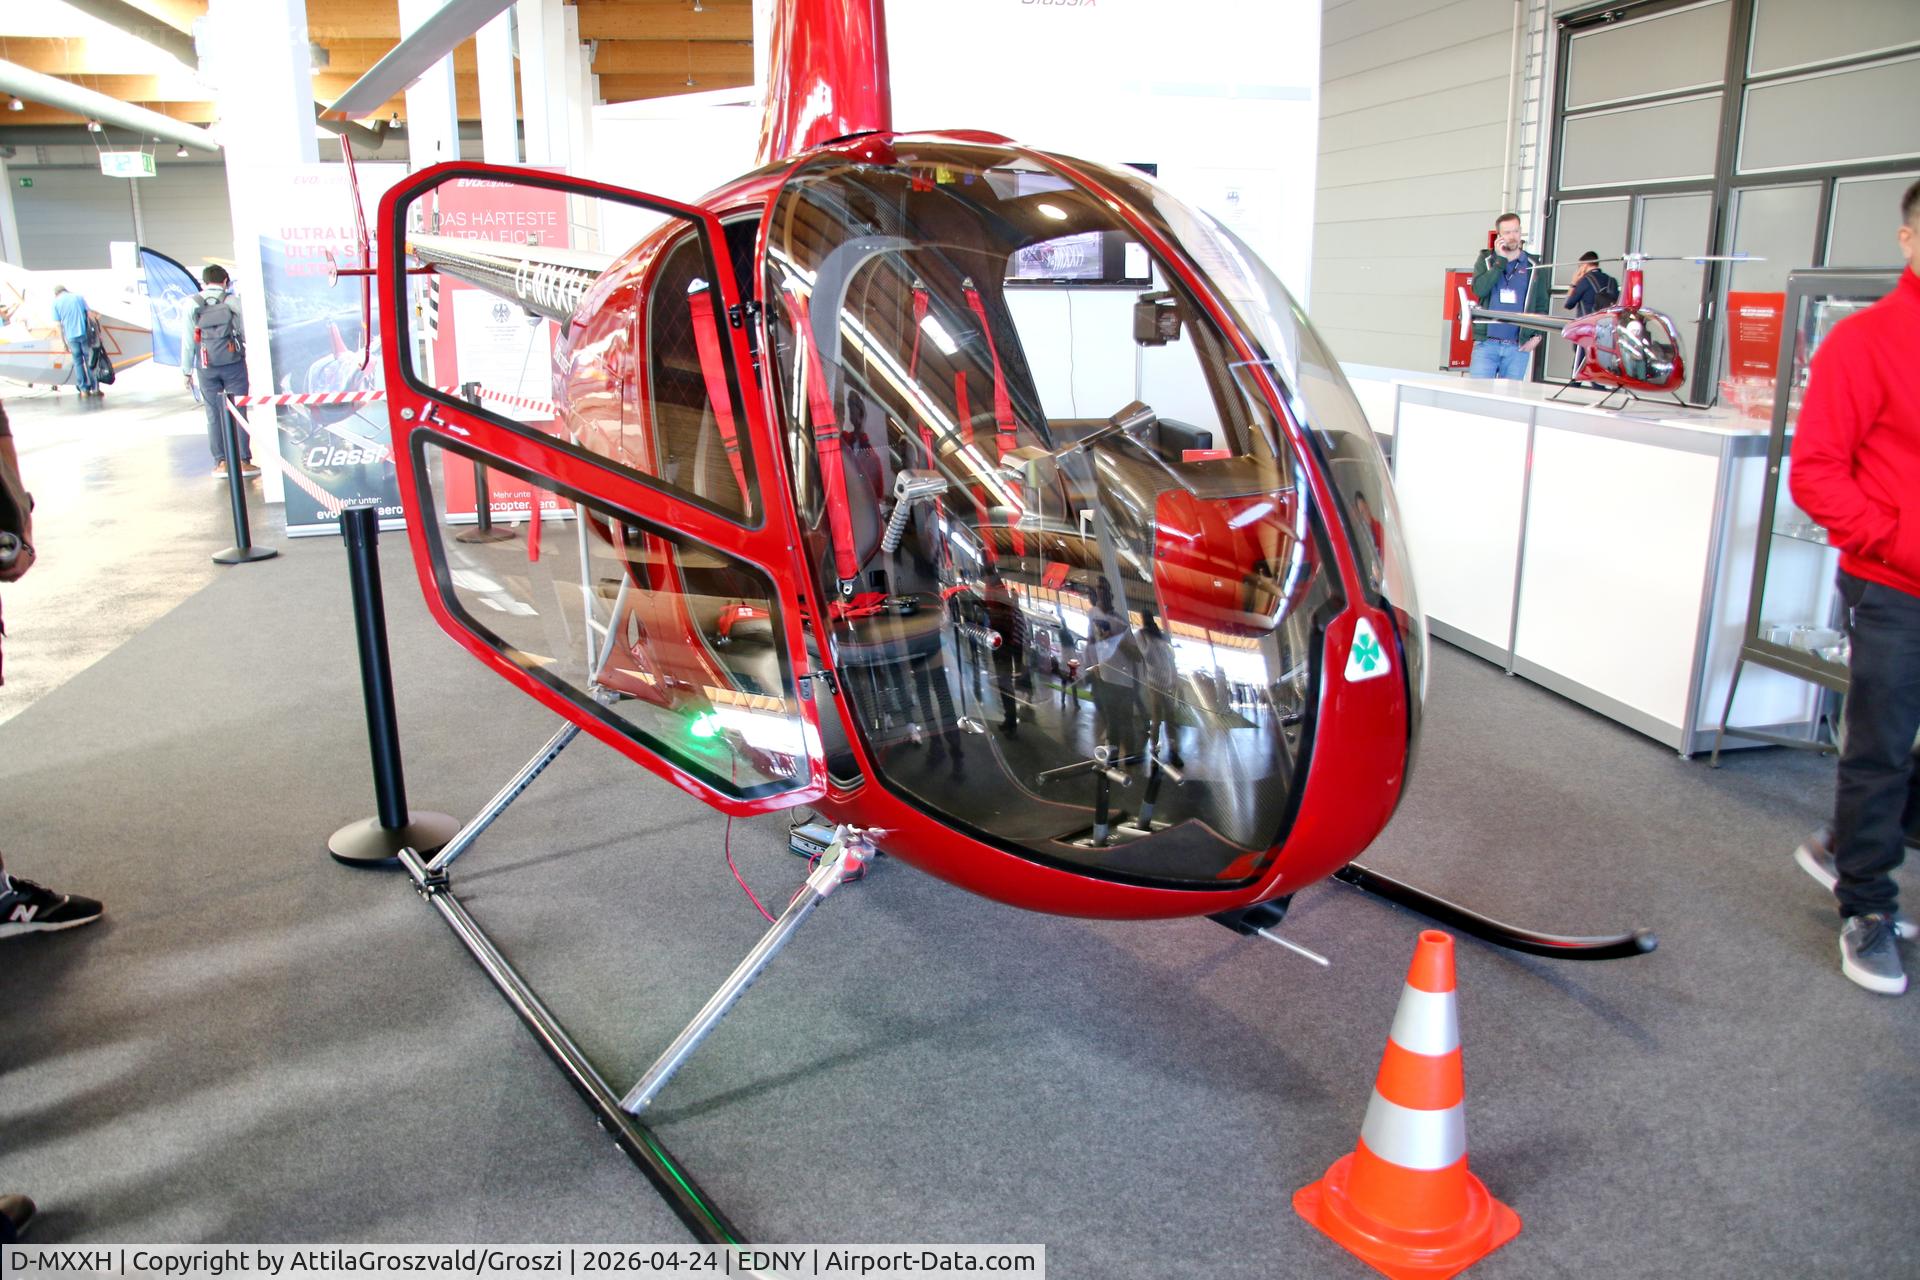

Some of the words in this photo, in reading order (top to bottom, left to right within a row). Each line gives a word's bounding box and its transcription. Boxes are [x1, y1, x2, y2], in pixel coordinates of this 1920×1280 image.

[472, 209, 558, 226] HÄRTESTE
[281, 227, 336, 240] ULTRA
[475, 500, 556, 513] ocopter.ero
